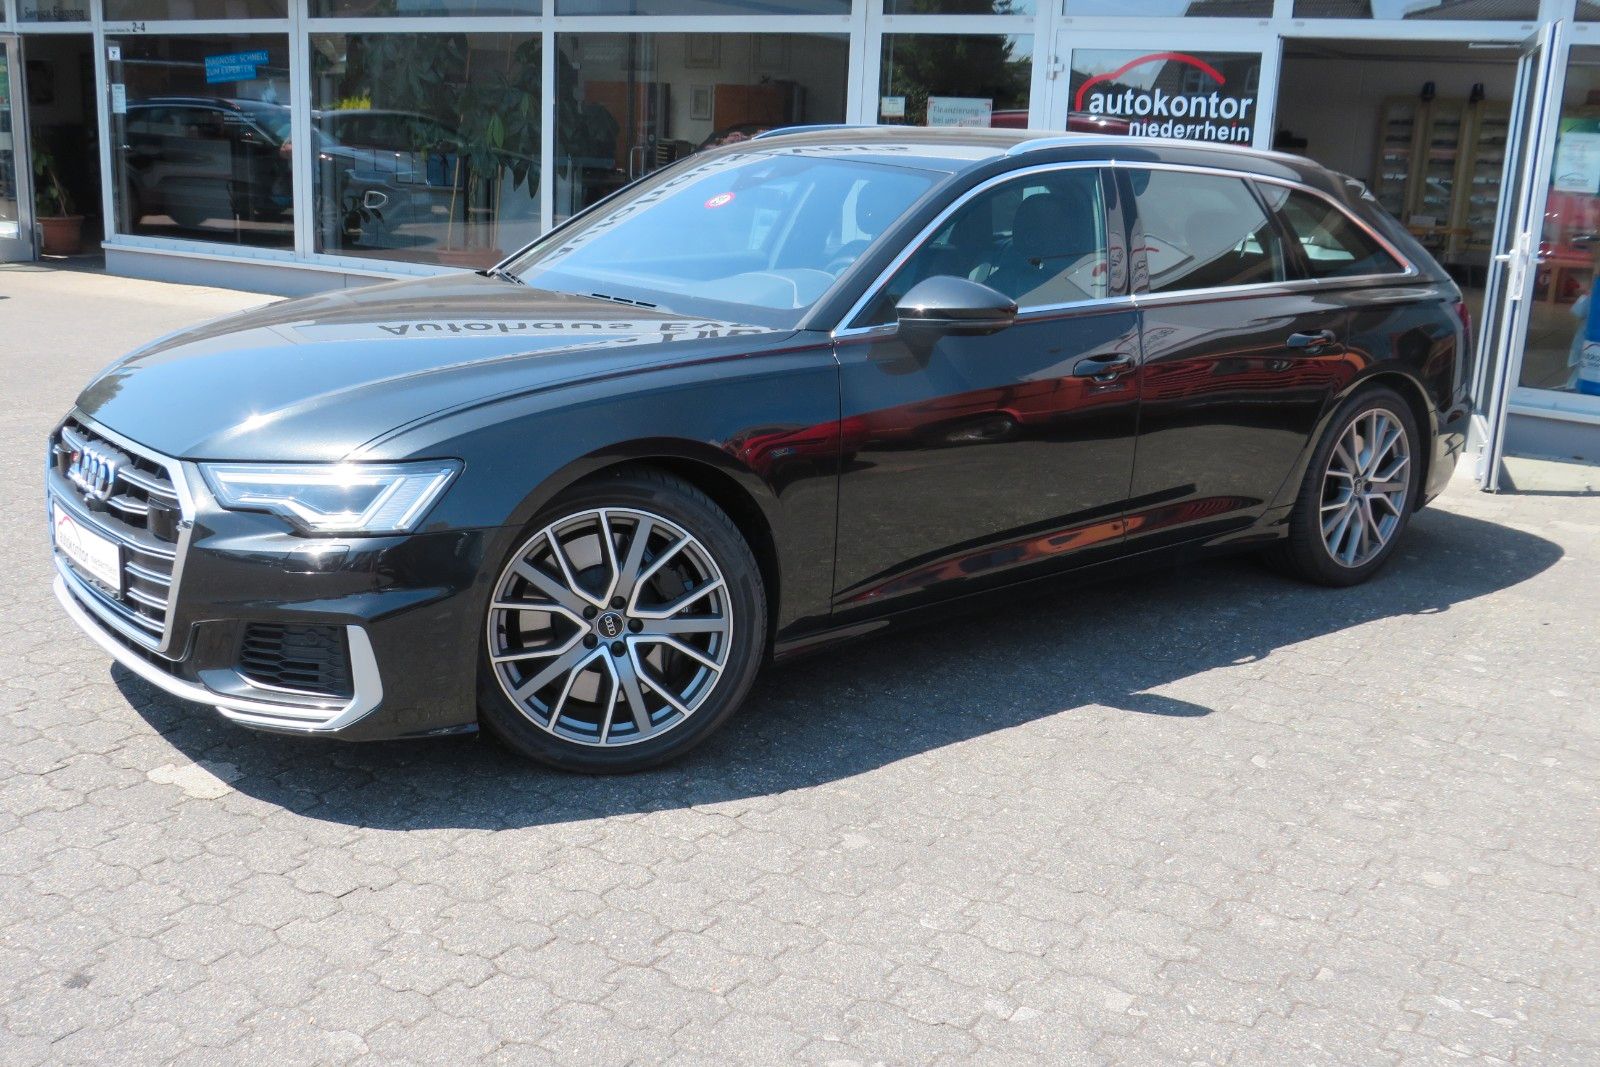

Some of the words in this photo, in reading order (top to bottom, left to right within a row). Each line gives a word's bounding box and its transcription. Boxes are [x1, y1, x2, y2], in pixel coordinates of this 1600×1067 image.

[132, 22, 146, 32] 2-4
[1088, 88, 1253, 120] autokontor
[1128, 119, 1250, 142] niederrhein
